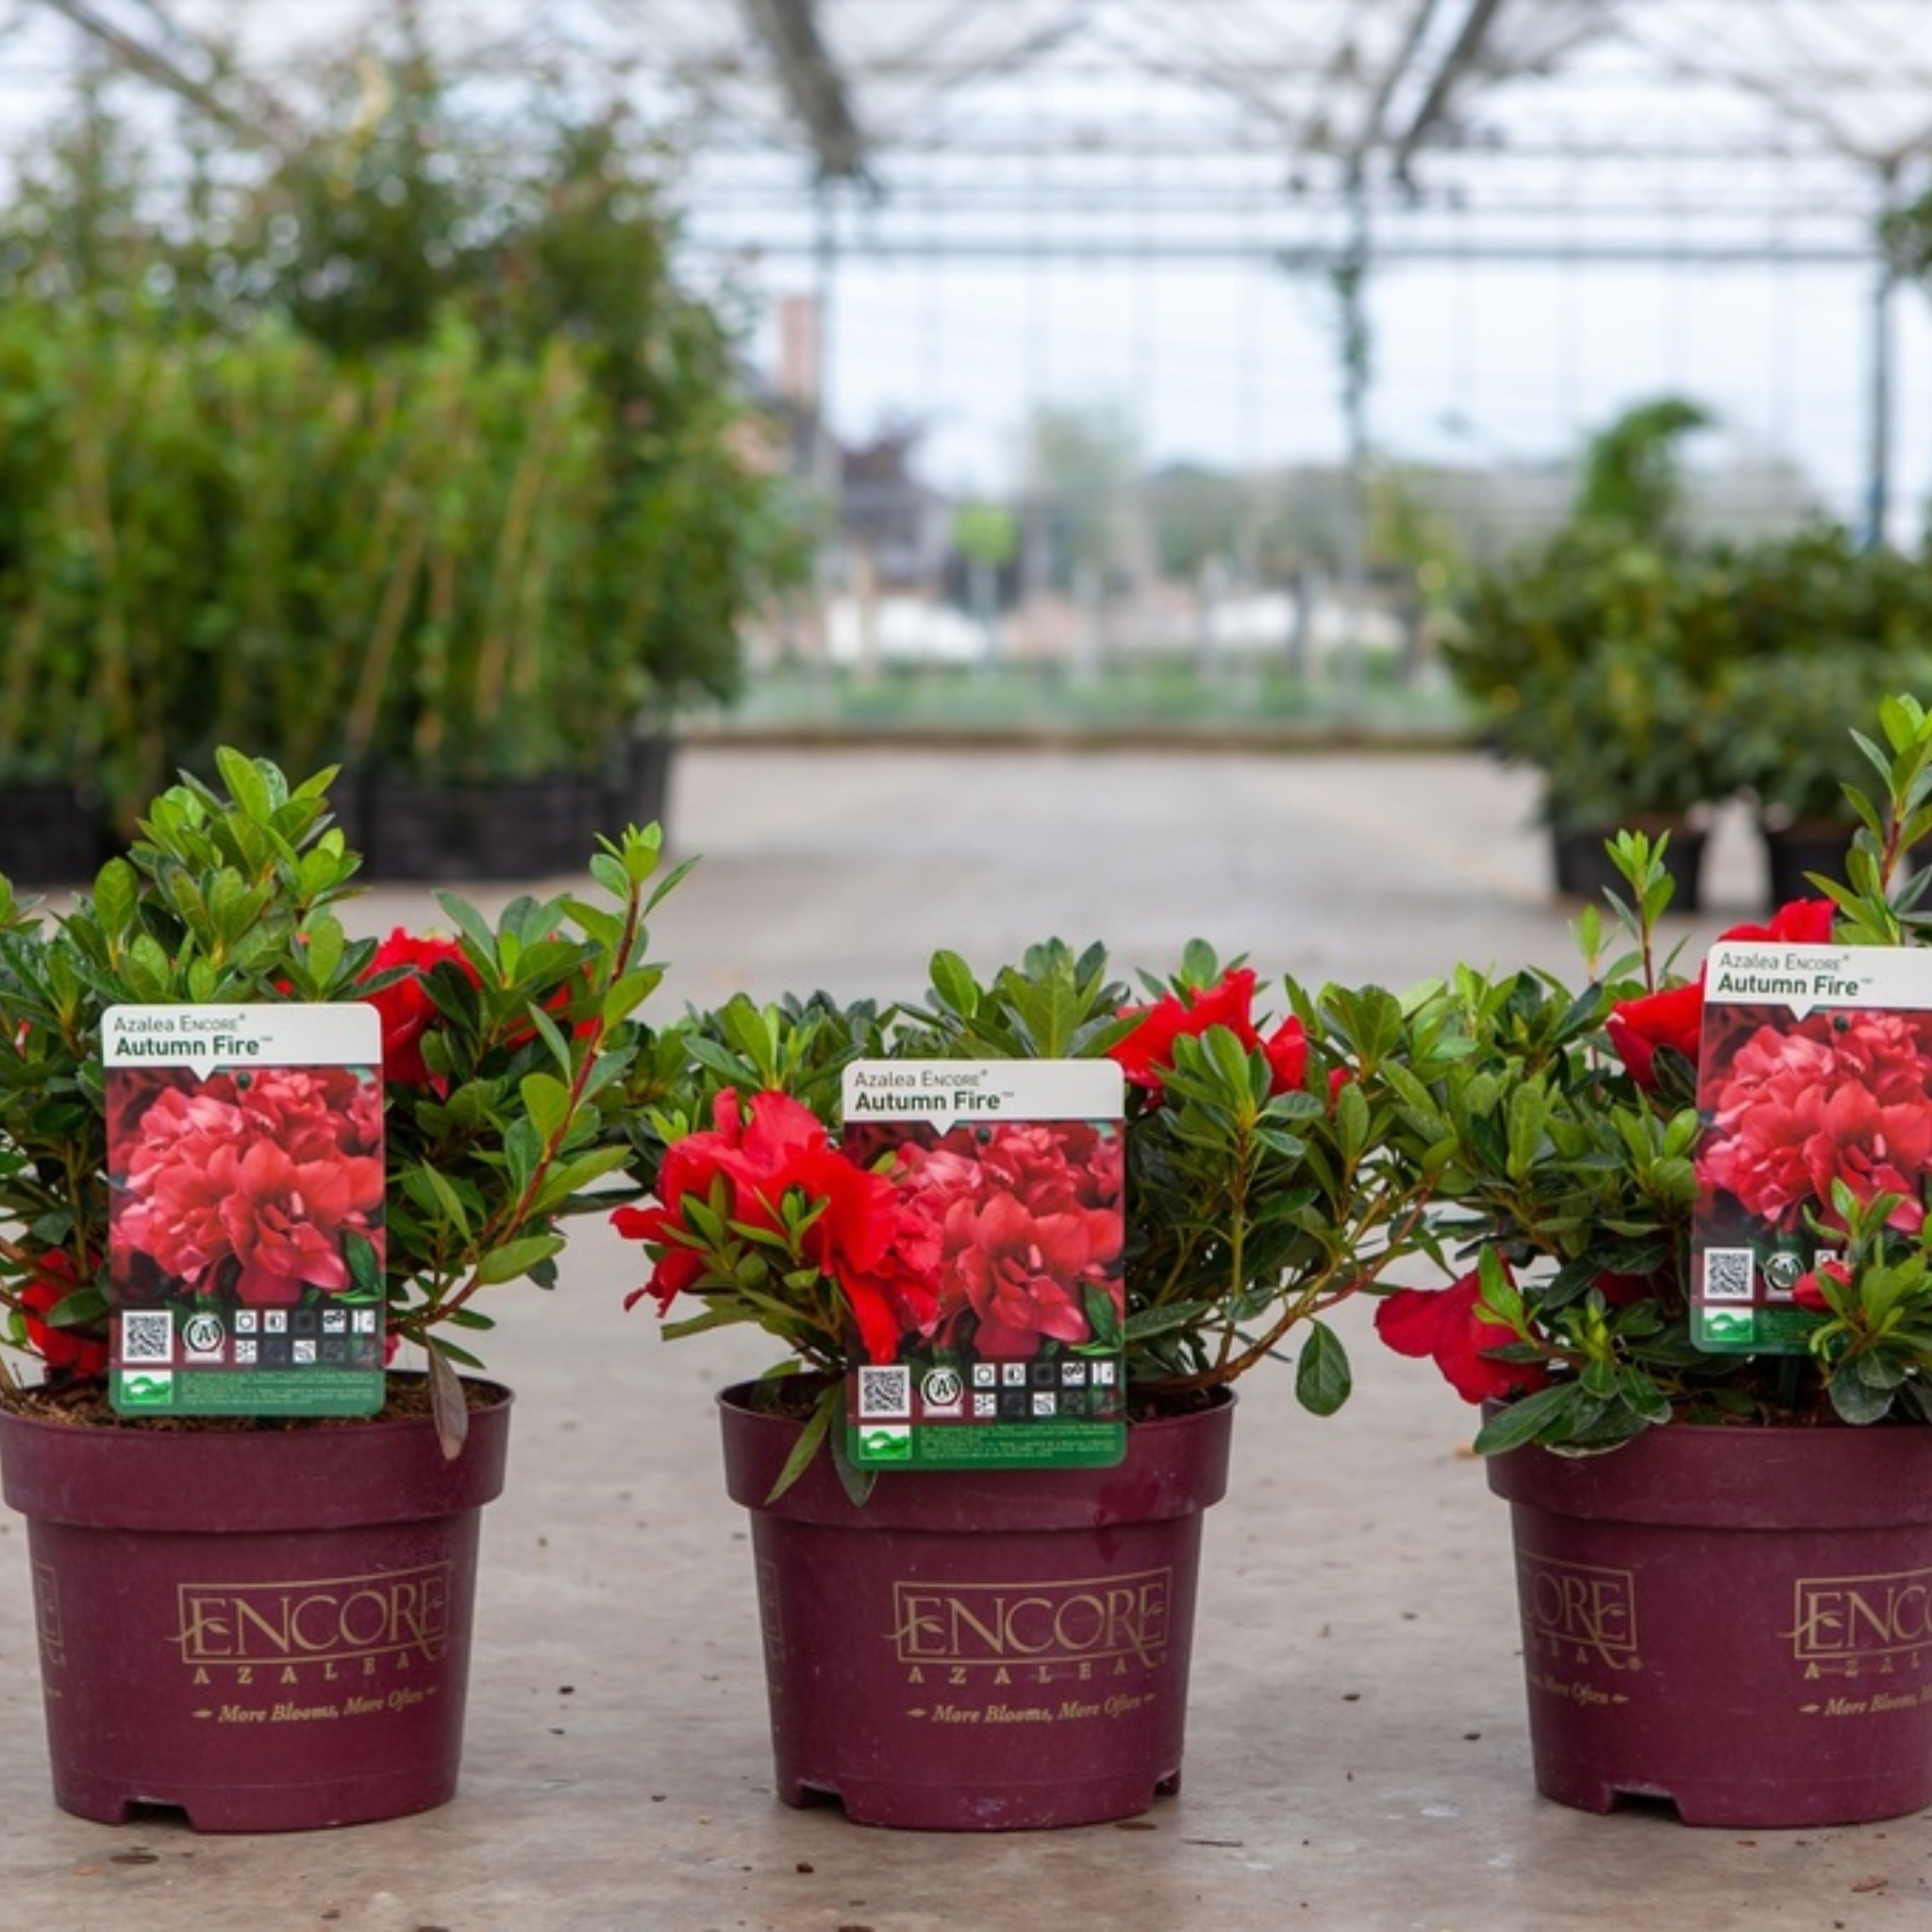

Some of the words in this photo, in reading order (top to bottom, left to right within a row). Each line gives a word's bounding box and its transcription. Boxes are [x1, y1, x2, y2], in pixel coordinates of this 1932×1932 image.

[1720, 952, 1779, 970] Azalea
[1718, 973, 1807, 993] Autumn
[114, 1015, 175, 1033] Azalea
[115, 1038, 206, 1056] Autumn
[855, 1071, 915, 1087] Azalea
[855, 1091, 946, 1110] Autumn
[189, 1576, 443, 1660] ENCORE
[903, 1583, 1164, 1667] ENCORE
[1805, 1584, 1932, 1650] ENC
[193, 1652, 409, 1684] AZALEA
[908, 1657, 1127, 1685] AZALEA
[218, 1705, 267, 1724] More
[270, 1701, 340, 1723] Blooms,
[932, 1706, 980, 1724] More
[985, 1703, 1054, 1724] Blooms,
[1823, 1697, 1868, 1717] More
